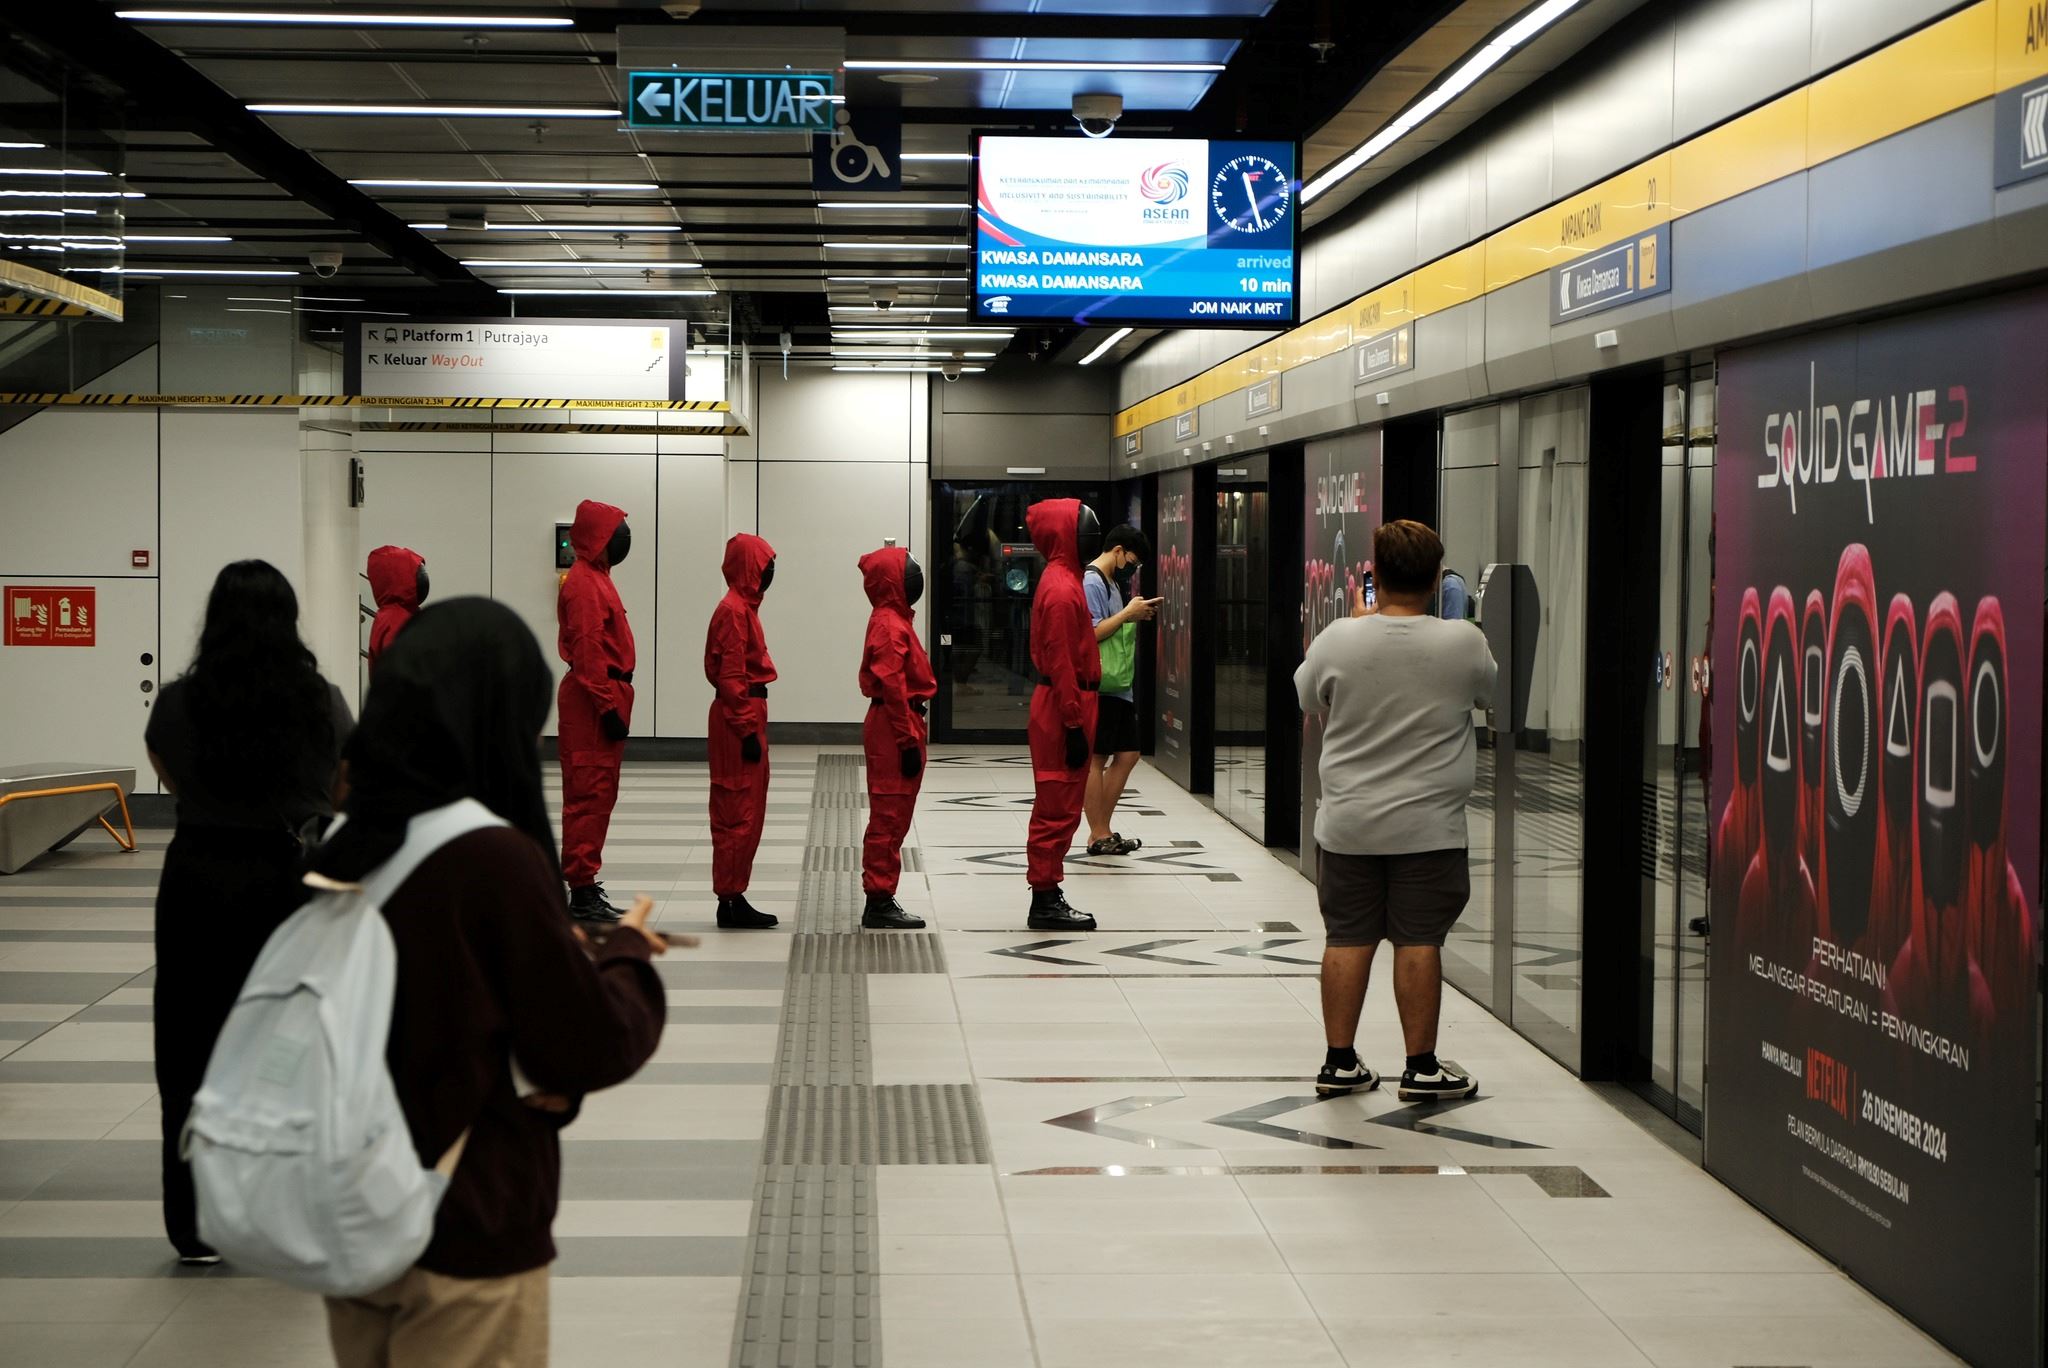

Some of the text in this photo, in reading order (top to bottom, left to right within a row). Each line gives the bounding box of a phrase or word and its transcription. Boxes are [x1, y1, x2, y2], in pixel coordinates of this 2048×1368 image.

[673, 78, 825, 125] KELUAR
[999, 191, 1128, 200] INCLUSIVITY AND SUSTAINABILITY
[1143, 208, 1189, 219] ASEAN
[1560, 178, 1657, 246] AMPANG PARK 20
[981, 251, 1292, 269] KWASA DAMANSARA arrived
[1576, 274, 1592, 300] Kwasa
[1592, 266, 1620, 295] Damansara
[1649, 242, 1656, 280] 2
[981, 274, 1292, 293] KWASA DAMANSARA 10 min
[1189, 301, 1283, 315] JOM NAIK MRT
[402, 328, 549, 347] Platform 1 Putrajaya
[384, 353, 485, 369] Keluar Way Out
[138, 395, 177, 403] MAXIMUM
[177, 395, 205, 403] HEIGHT
[378, 397, 424, 405] KETINGGIAN
[576, 400, 614, 408] MAXIMUM
[1758, 361, 1977, 524] SQUID GAME 2
[1812, 936, 1886, 991] PERHATIAN!
[1749, 952, 1969, 1072] MELANGGAR PERATURAN = PENYINGKIRAN
[1761, 1039, 1948, 1163] HANYA MELALUI NETFLIX 26 DISEMBER 2024
[1787, 1113, 1805, 1141] PELAN
[1805, 1123, 1830, 1156] BERMULA
[1830, 1138, 1858, 1173] DARIPADA
[1880, 1168, 1909, 1205] SEBULAN
